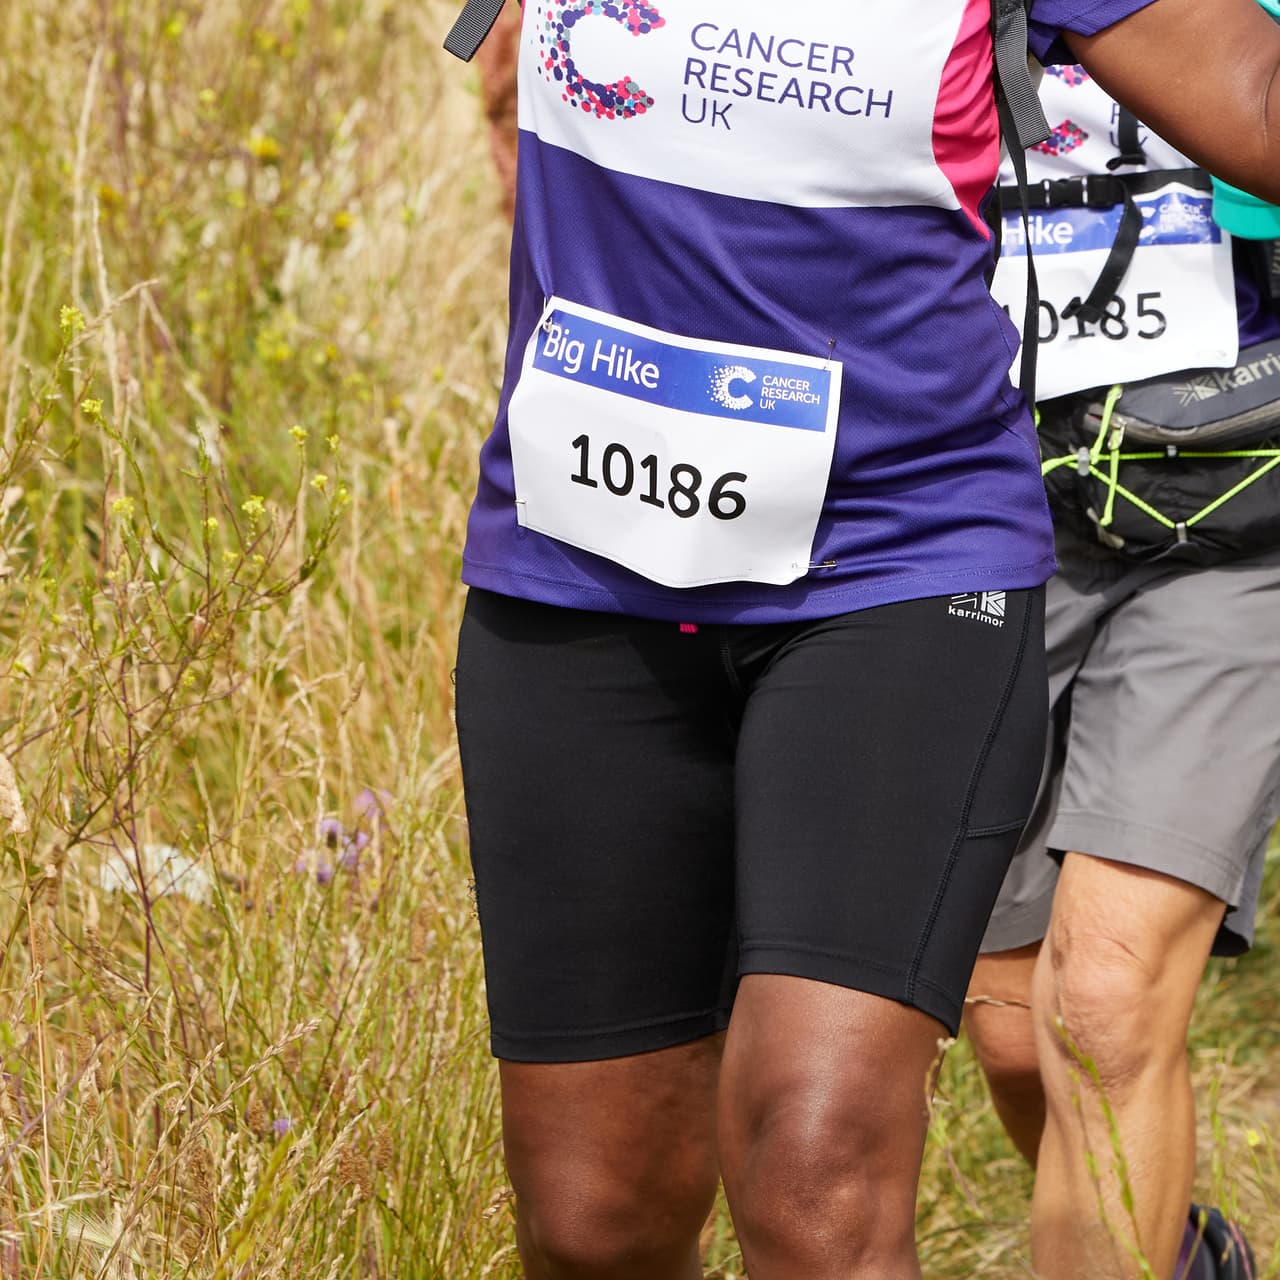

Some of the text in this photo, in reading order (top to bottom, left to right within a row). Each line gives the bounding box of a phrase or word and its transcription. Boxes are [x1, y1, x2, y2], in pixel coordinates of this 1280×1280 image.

[690, 22, 855, 77] CANCER
[683, 57, 893, 118] RESEARCH
[681, 93, 733, 131] UK
[1000, 216, 1074, 246] Hike
[1002, 292, 1168, 345] 0185
[542, 324, 660, 389] Big Hike
[761, 387, 821, 405] RESEARCH
[762, 375, 810, 392] CANCER
[760, 398, 776, 410] UK
[570, 434, 748, 521] 10186
[948, 605, 1005, 628] karrimor
